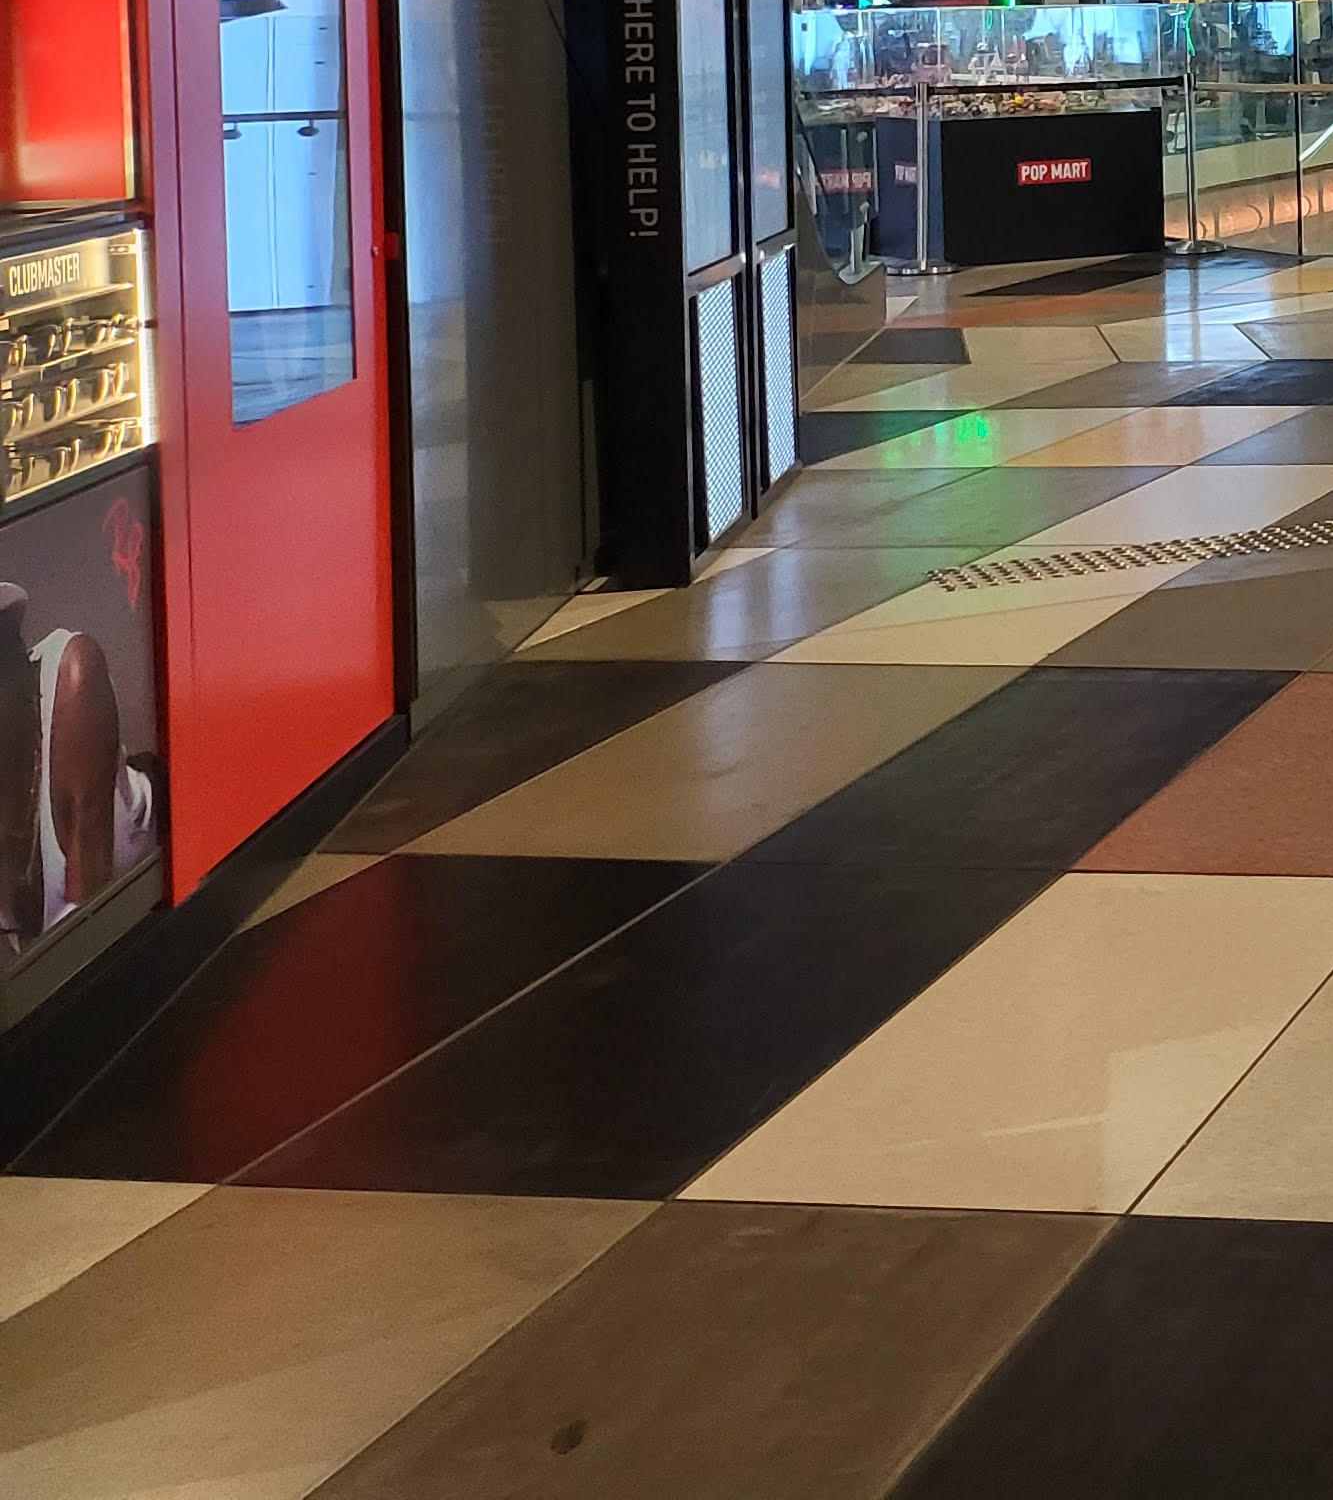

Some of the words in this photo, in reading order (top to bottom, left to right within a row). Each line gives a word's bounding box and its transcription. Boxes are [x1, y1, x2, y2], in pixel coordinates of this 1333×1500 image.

[626, 92, 657, 133] TO
[626, 143, 660, 239] HELP!
[1021, 164, 1048, 182] POP
[1050, 161, 1089, 180] MART
[8, 252, 81, 297] CLUBMASTER
